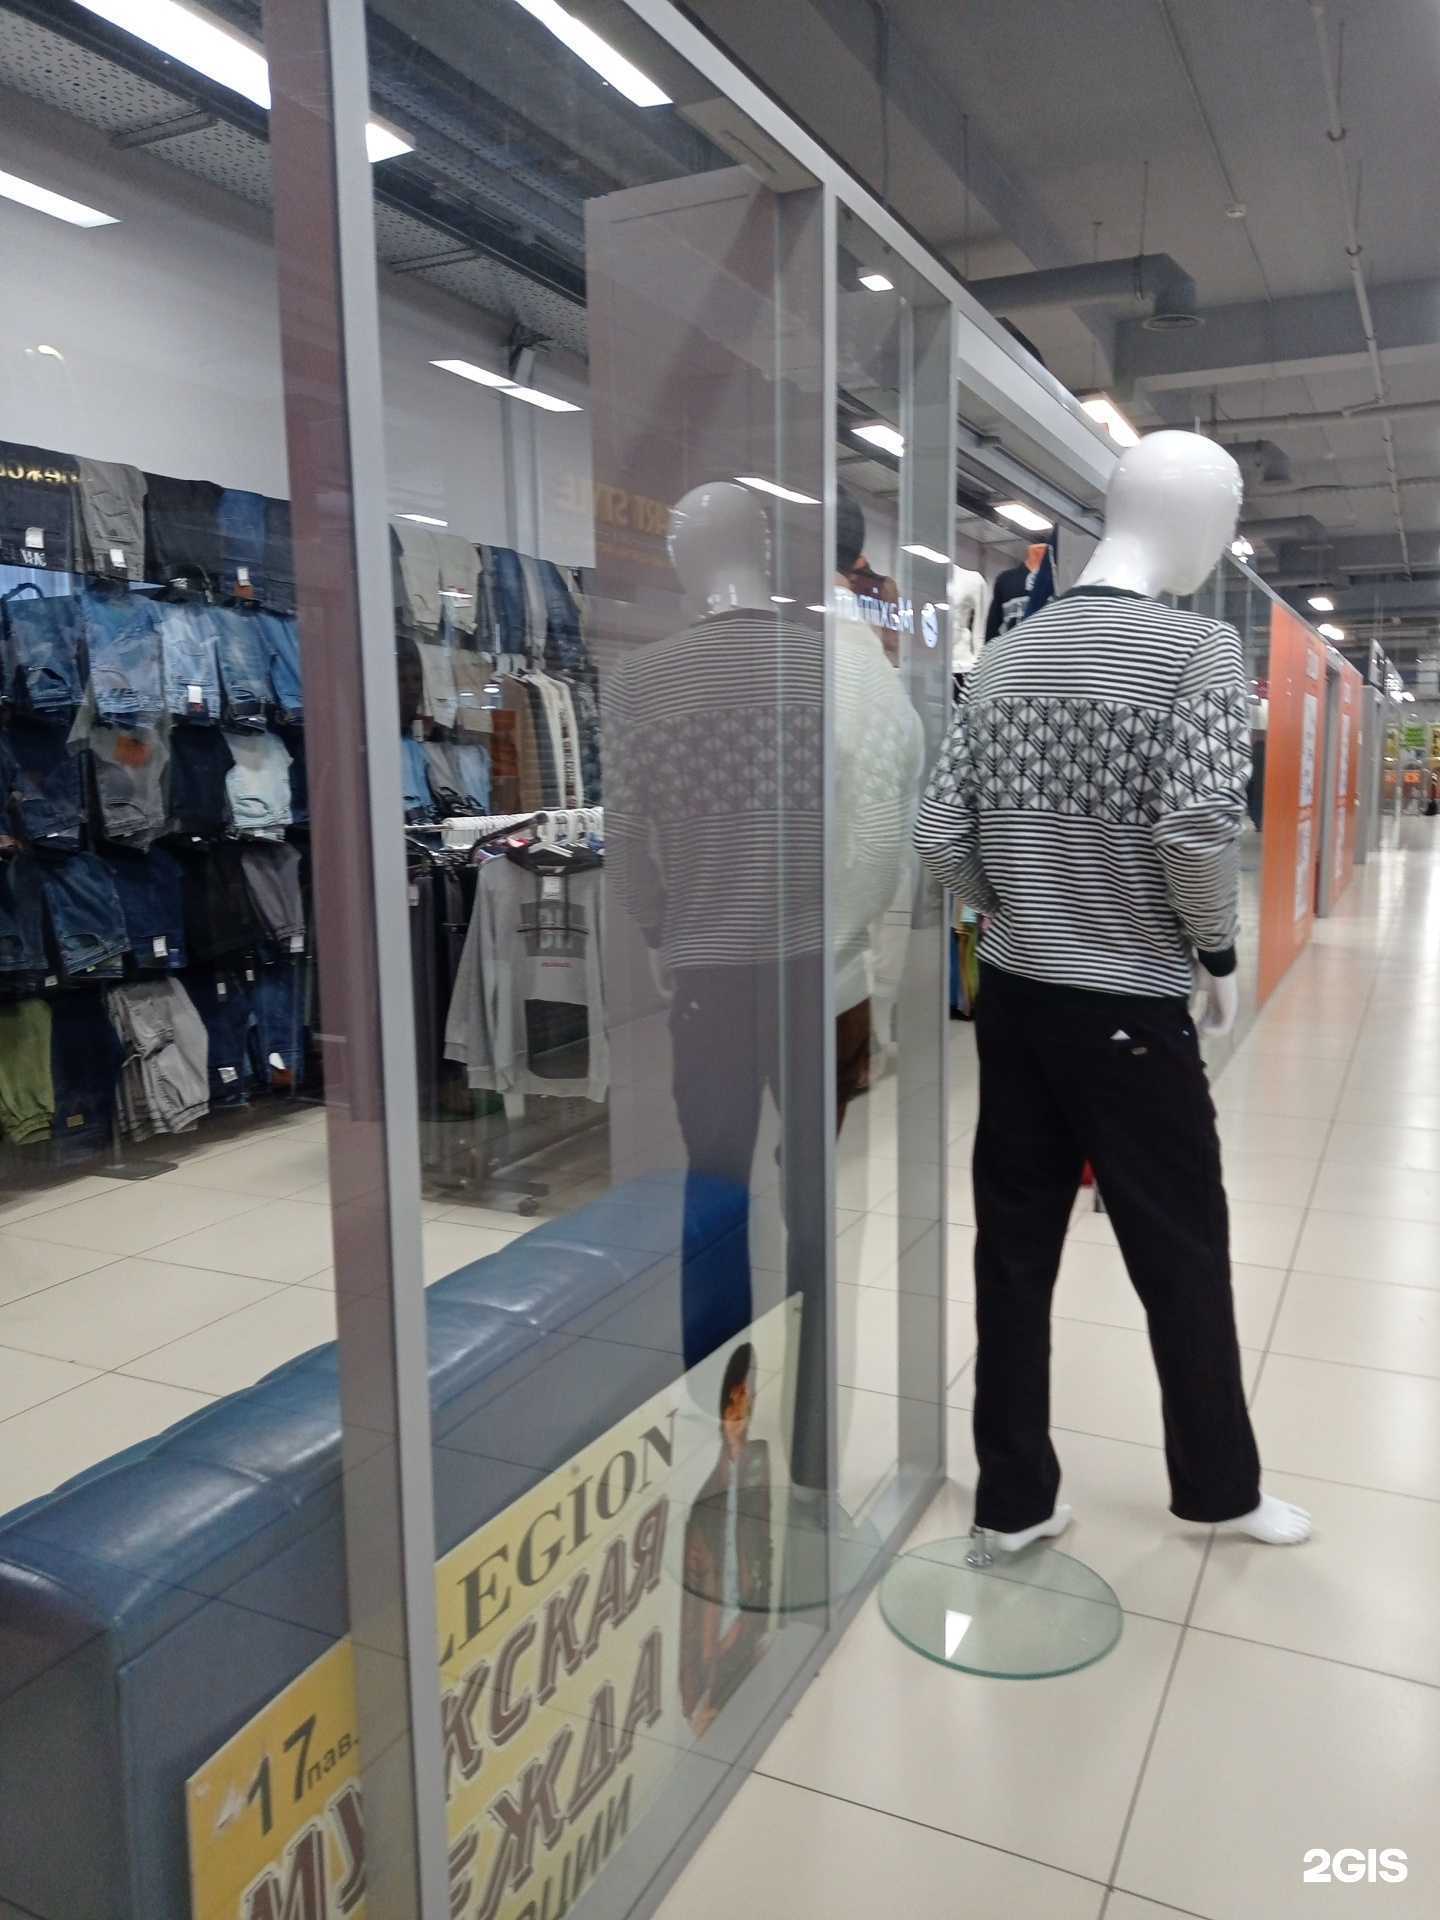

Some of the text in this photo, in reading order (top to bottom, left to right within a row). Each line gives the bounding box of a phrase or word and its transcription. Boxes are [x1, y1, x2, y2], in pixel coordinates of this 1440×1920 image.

[439, 1408, 679, 1667] EGION
[247, 1713, 317, 1837] 17
[514, 1772, 635, 1920] ЦИИ
